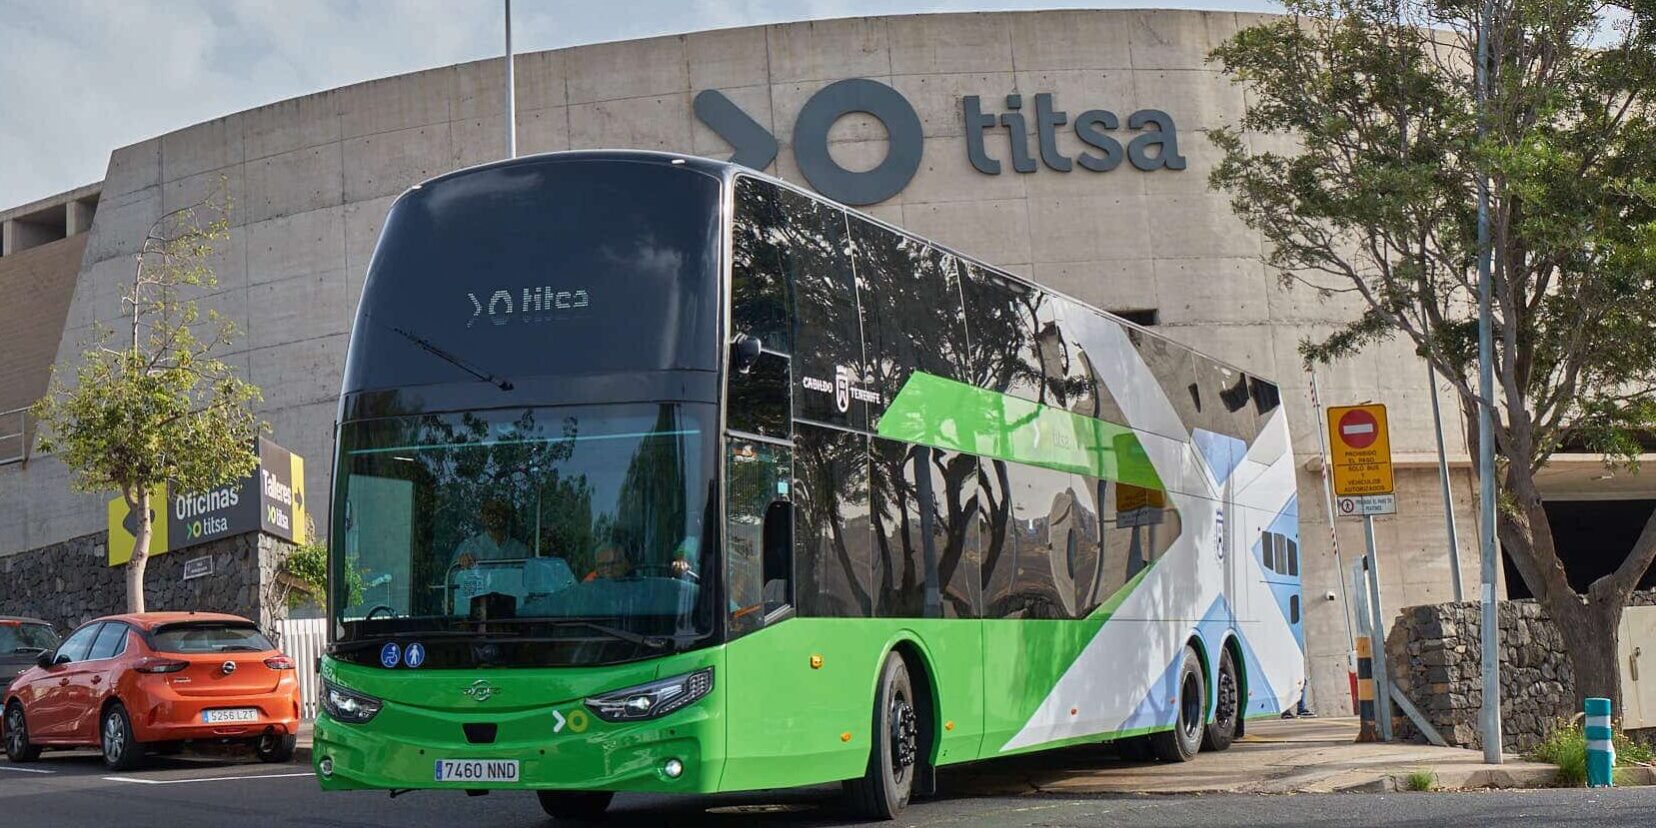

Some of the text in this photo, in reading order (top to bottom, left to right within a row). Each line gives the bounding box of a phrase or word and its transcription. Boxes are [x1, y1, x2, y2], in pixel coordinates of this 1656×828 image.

[963, 92, 1187, 176] titsa
[802, 376, 881, 404] CABILDO TENERIFE
[262, 468, 292, 506] Talleres
[175, 486, 239, 520] Oficinas
[203, 516, 228, 535] titsa
[276, 508, 290, 530] titsa
[211, 711, 234, 721] 5256
[445, 762, 516, 779] 7460 NND
